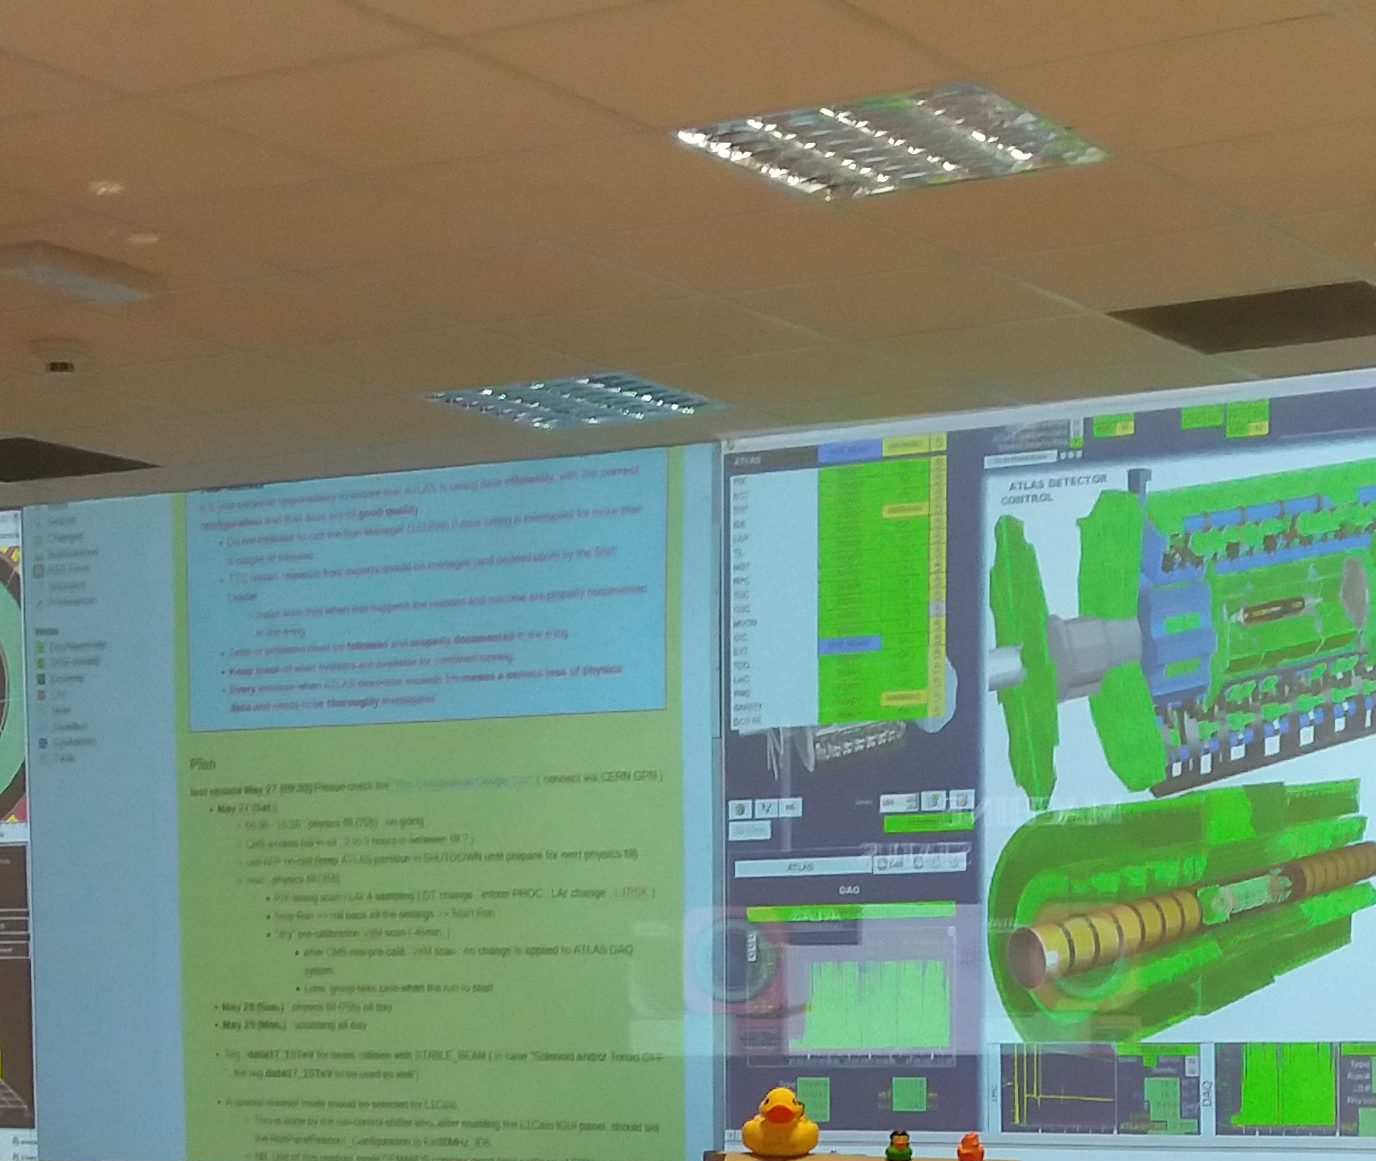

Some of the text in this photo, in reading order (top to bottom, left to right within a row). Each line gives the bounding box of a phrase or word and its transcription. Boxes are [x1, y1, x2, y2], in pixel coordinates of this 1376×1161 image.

[1009, 473, 1108, 492] ATLAS DETECTOR
[1001, 493, 1054, 506] CONTROL
[190, 757, 217, 771] Plan
[601, 771, 631, 783] CERN
